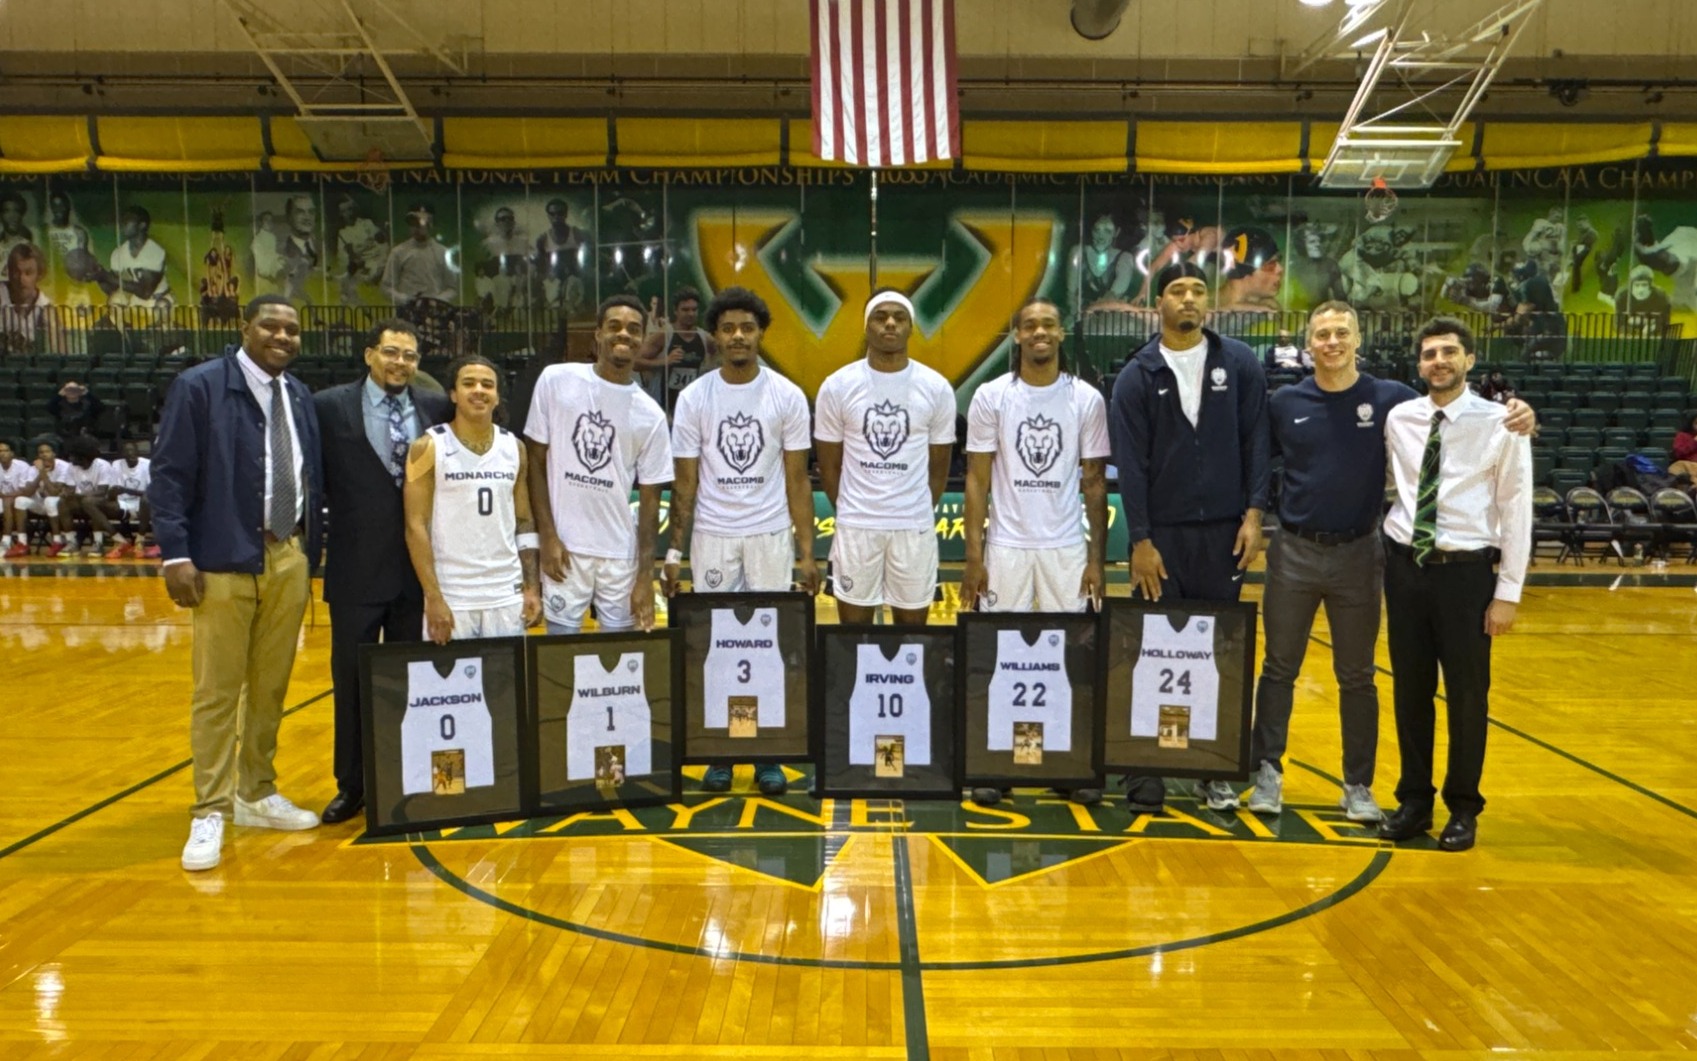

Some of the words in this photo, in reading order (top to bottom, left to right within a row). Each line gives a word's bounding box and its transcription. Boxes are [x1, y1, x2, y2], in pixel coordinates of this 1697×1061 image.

[403, 168, 541, 184] NATIONAL
[552, 167, 620, 185] TEAM
[930, 170, 1066, 185] ACADEMIC
[1511, 167, 1592, 189] NCAA
[1598, 166, 1695, 189] CHAMP
[860, 461, 909, 471] MACOMB
[445, 471, 515, 481] MONARCHS
[564, 472, 614, 489] MACOMB
[717, 477, 764, 485] MACOMB
[1014, 480, 1061, 489] MACOMB
[478, 487, 493, 516] 0
[716, 639, 773, 649] HOWARD
[1142, 648, 1212, 660] HOLLOWAY
[736, 659, 752, 684] 3
[1000, 661, 1061, 671] WILLIAMS
[865, 673, 914, 685] IRVING
[1158, 668, 1191, 695] 24
[577, 685, 641, 698] WILBURN
[1012, 682, 1047, 707] 22
[409, 692, 482, 708] JACKSON
[878, 693, 904, 718] 10
[440, 713, 455, 741] 0
[606, 706, 615, 732] 1
